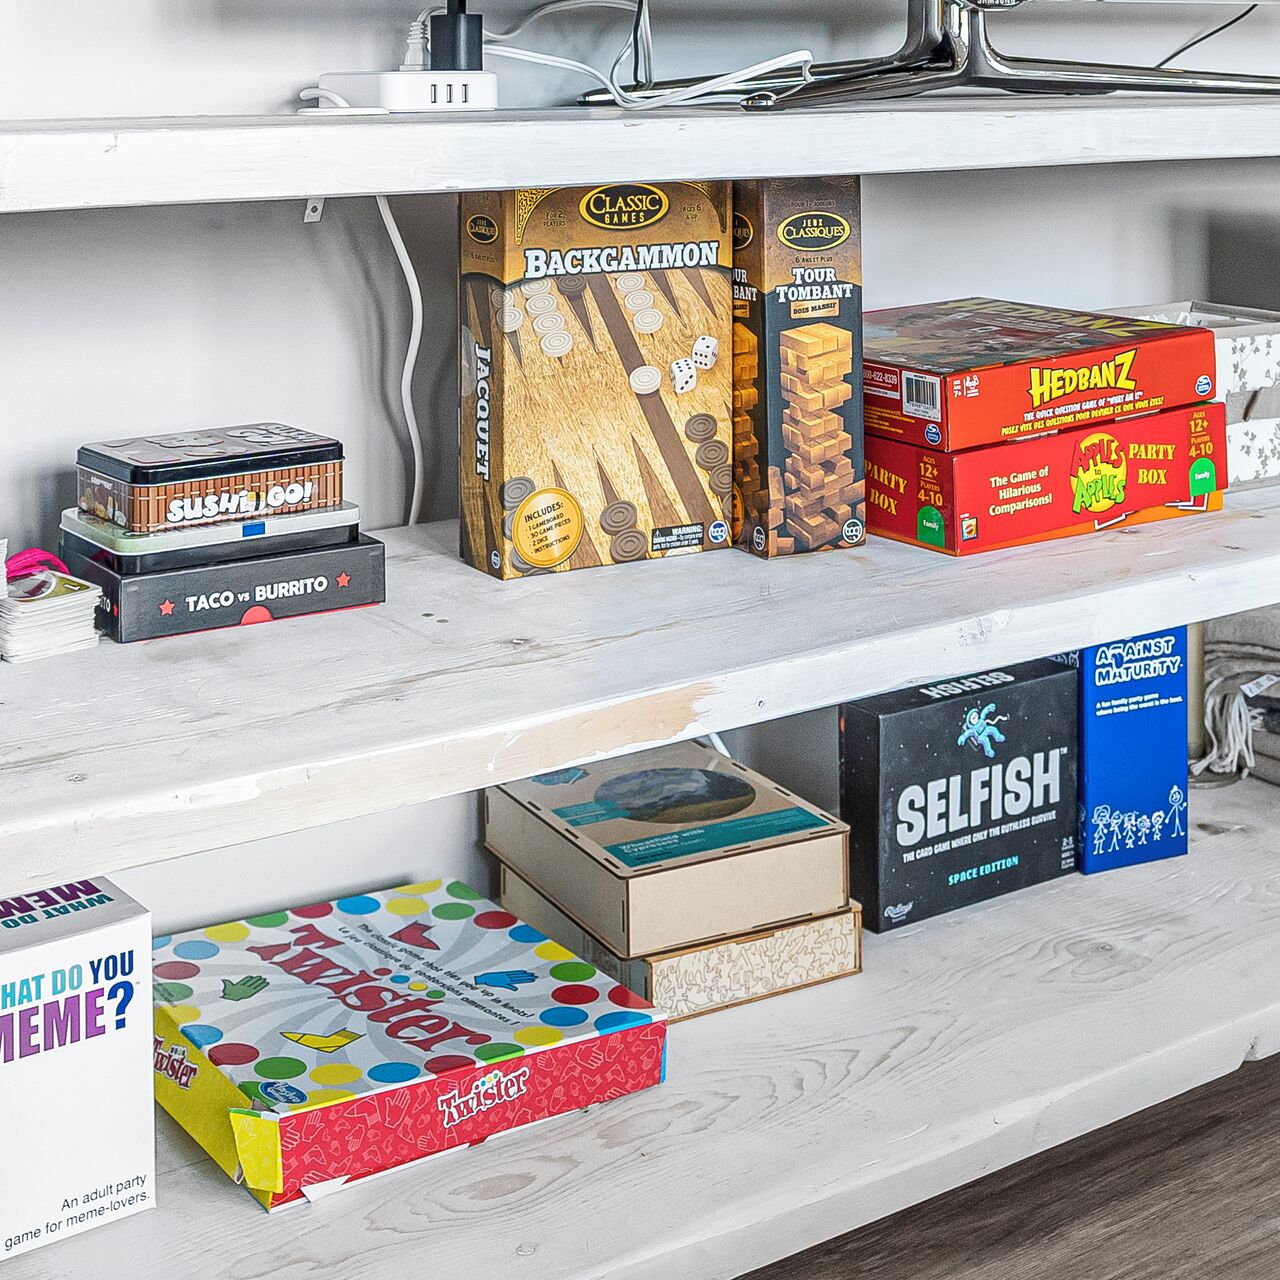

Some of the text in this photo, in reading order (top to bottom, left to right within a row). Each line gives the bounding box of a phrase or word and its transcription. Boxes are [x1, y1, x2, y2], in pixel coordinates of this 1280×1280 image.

[589, 193, 659, 213] CLASSIC
[605, 212, 645, 224] GAMES
[802, 219, 823, 227] JEUX
[784, 226, 844, 239] CLASSIQUES
[525, 242, 719, 279] BACKGAMMON
[792, 268, 836, 284] TOUR
[776, 284, 853, 302] TOMBANT
[1028, 348, 1138, 408] HEDBANZ
[474, 342, 492, 482] JACQUET
[1189, 419, 1209, 434] 12+
[1128, 443, 1177, 461] PARTY
[1189, 442, 1214, 458] 4-10
[864, 459, 908, 495] PARTY
[919, 463, 939, 478] 12+
[989, 466, 1049, 488] The Game of
[1094, 468, 1101, 476] to
[1138, 468, 1167, 485] BOX
[1194, 470, 1211, 480] Family
[266, 481, 314, 507] GO!
[870, 487, 898, 516] BOX
[918, 489, 943, 507] 4-10
[999, 483, 1042, 500] Hilarious
[1072, 473, 1126, 515] APPLES
[524, 501, 564, 523] INCLUDES:
[989, 493, 1053, 516] Comparisons!
[532, 513, 565, 529] GAMEBOARD
[539, 526, 554, 537] GAME
[554, 518, 571, 531] PIECES
[671, 525, 703, 535] WARNING:
[534, 534, 570, 554] INSTRUCTIONS
[185, 589, 235, 612] TACO
[254, 576, 328, 602] BURRITO
[920, 671, 1015, 699] SELFISH
[896, 748, 1061, 846] SELFISH
[903, 810, 1056, 863] THE CARD GAME WHERE ONLY THE RUTHLESS SURVIVE
[947, 855, 1019, 885] SPACE EDITION
[42, 893, 114, 919] WHAT
[3, 913, 39, 929] DO
[52, 964, 82, 991] DO
[89, 950, 135, 983] YOU
[338, 926, 349, 934] Le
[346, 933, 362, 944] jeu
[363, 941, 401, 965] classique
[399, 963, 413, 971] de
[414, 970, 464, 998] contorsions
[461, 996, 512, 1024] amusantes
[358, 923, 536, 1019] The classic game that ties you up in knots!
[247, 923, 491, 1052] Twister
[438, 1067, 529, 1128] Twister
[61, 1173, 147, 1212] An adult party
[4, 1192, 150, 1251] game for meme-lovers.
